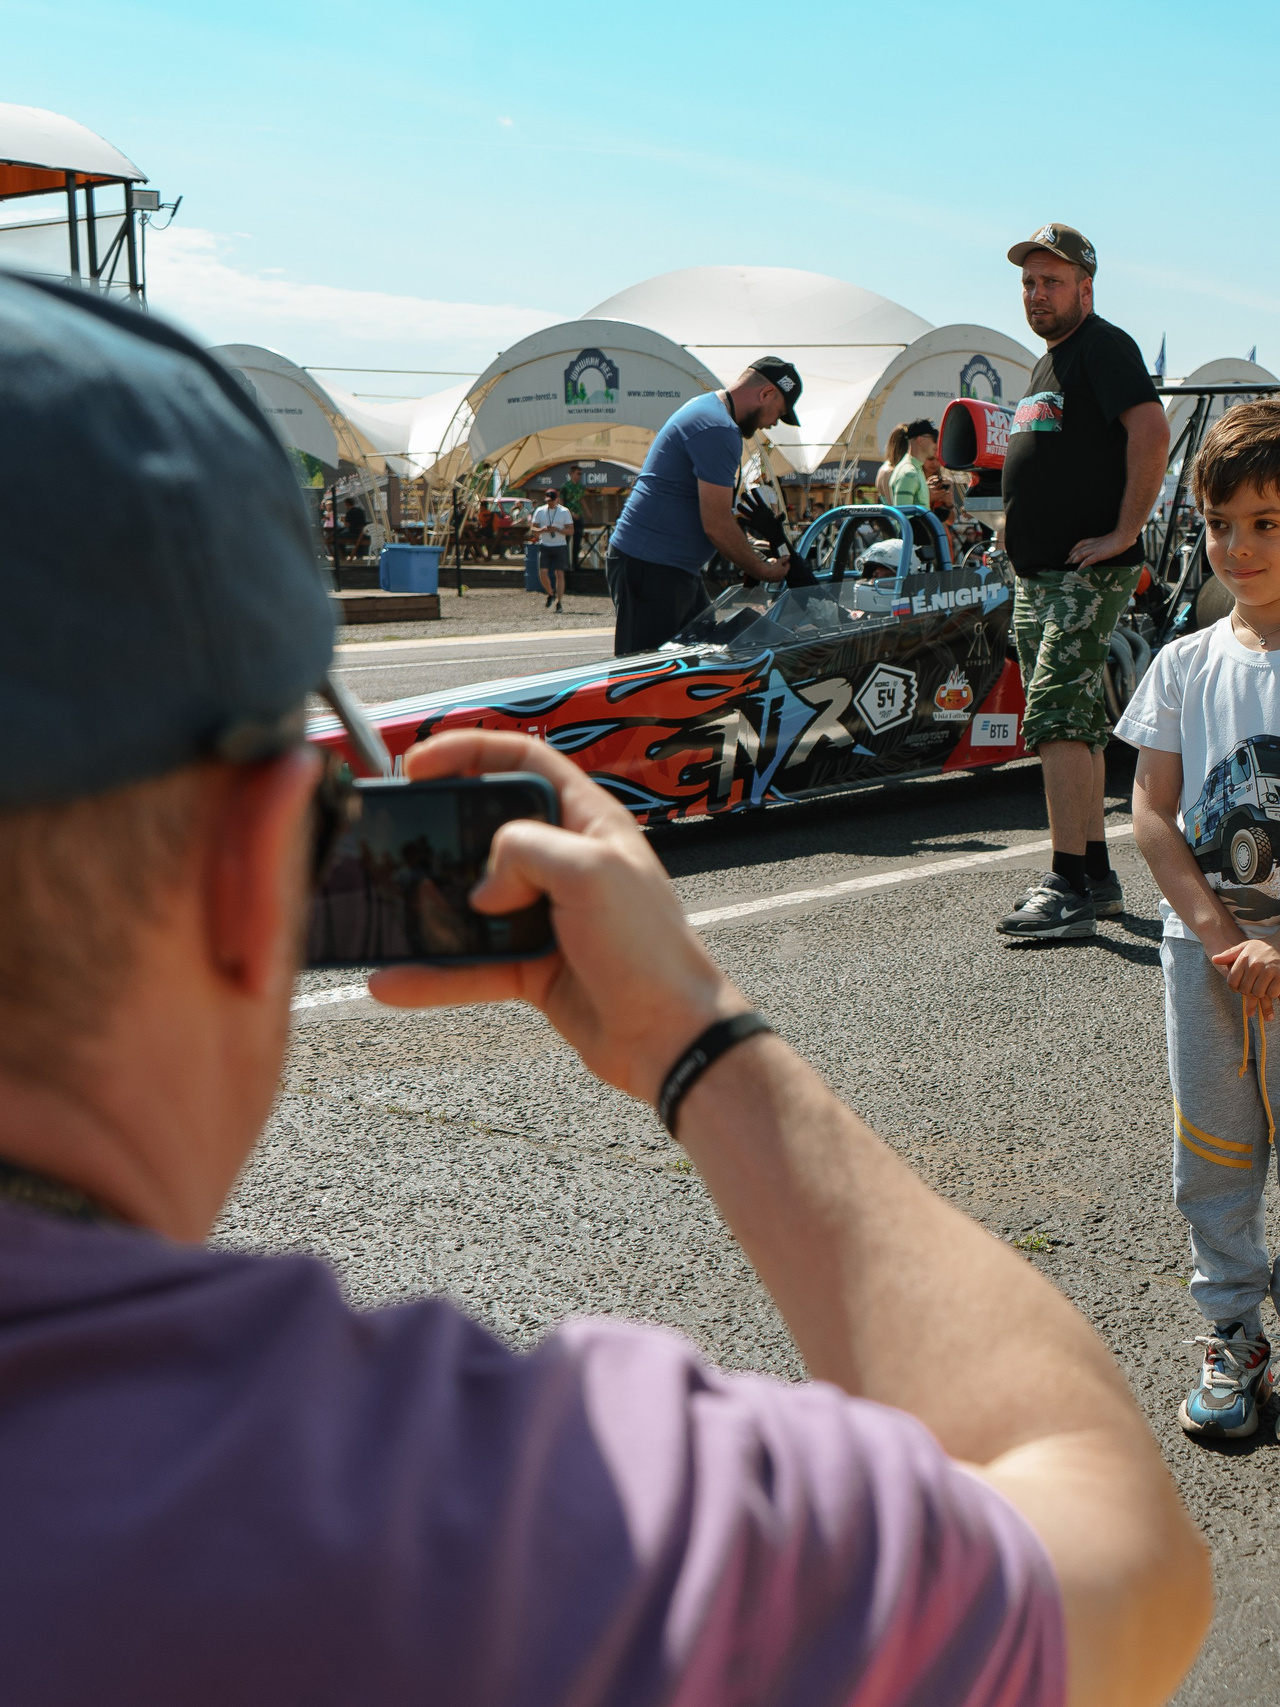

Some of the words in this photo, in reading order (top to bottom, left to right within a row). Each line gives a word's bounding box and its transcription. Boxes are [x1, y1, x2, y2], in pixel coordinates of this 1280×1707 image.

[986, 427, 1010, 447] RID
[587, 473, 608, 484] СМИ
[912, 582, 1002, 614] E.NIGHT
[877, 689, 896, 709] 54
[989, 723, 1009, 739] ВТБ
